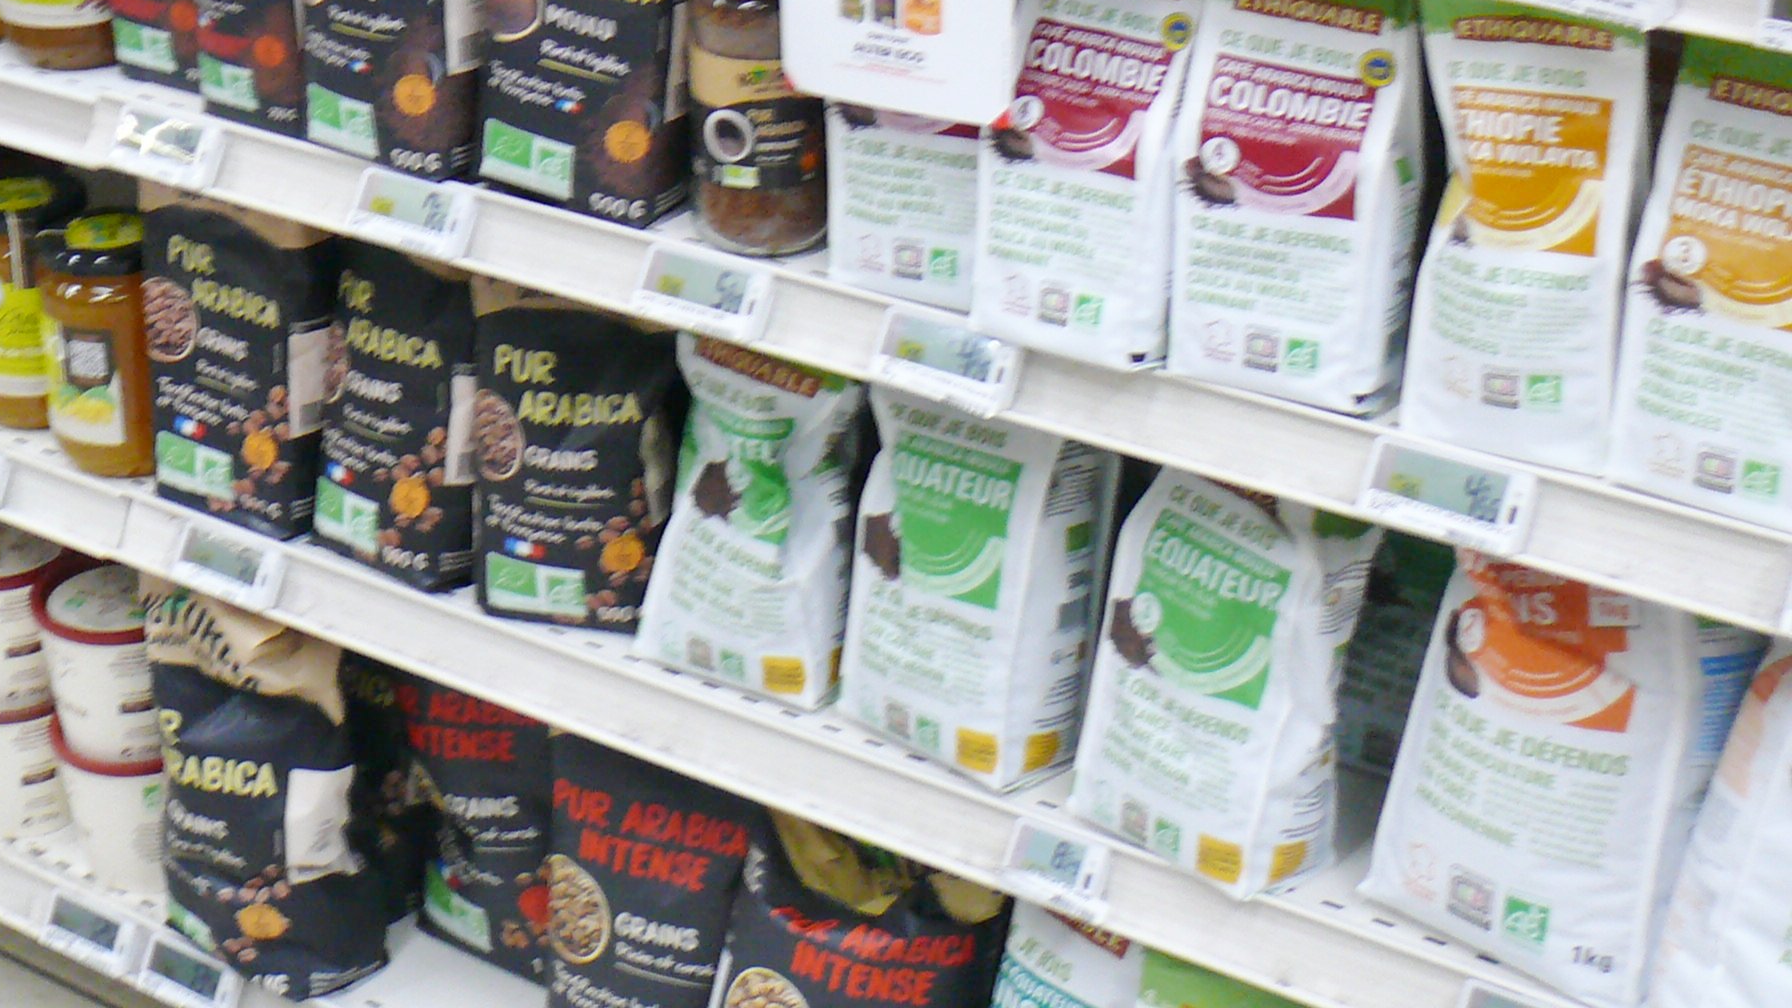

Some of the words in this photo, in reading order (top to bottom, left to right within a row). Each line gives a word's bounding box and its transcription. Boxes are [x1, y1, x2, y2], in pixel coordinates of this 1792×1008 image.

[1458, 17, 1614, 50] ETHIQUABLE
[1028, 38, 1170, 93] COLOMBIE
[1209, 74, 1373, 130] COLOMBIE
[1459, 107, 1565, 143] THIOPIE
[166, 233, 218, 277] PUR
[345, 316, 444, 370] ARABICA
[494, 342, 559, 385] PUR
[518, 389, 644, 427] ARABICA
[523, 444, 599, 472] GRAINS
[895, 451, 1013, 512] QUATEUR
[163, 746, 279, 799] RABICA
[1519, 734, 1632, 777] DÉFENDS
[551, 777, 613, 828] PUR
[619, 800, 749, 858] ARABICA
[577, 826, 712, 893] INTENSE
[613, 911, 700, 953] GRAINS
[840, 921, 978, 967] ARABICA
[790, 939, 939, 1007] INTENSE
[1570, 943, 1614, 973] 1kg
